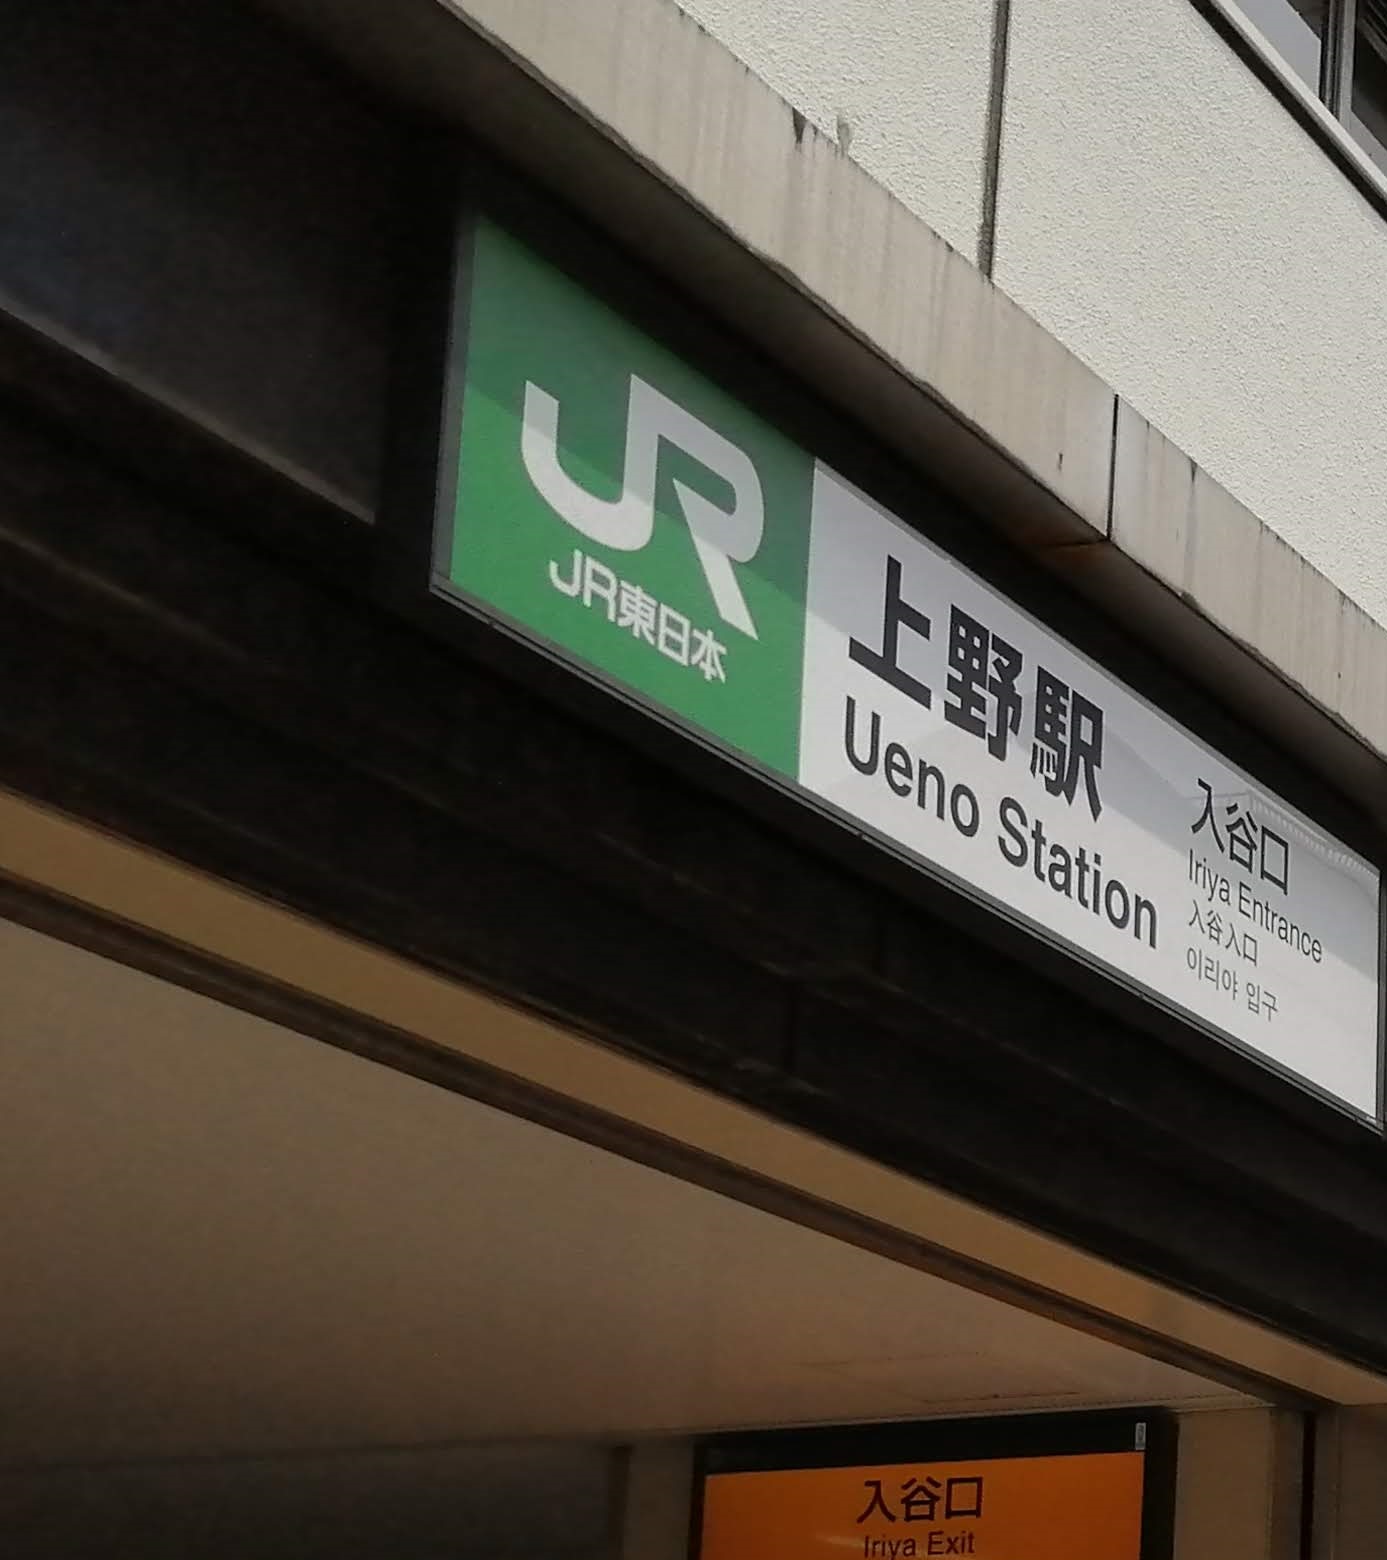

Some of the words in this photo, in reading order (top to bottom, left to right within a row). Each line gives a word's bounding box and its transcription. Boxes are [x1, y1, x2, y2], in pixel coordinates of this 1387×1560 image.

[521, 373, 765, 641] JR
[549, 549, 728, 684] JR東日本
[848, 554, 1104, 823] 上野駅
[844, 695, 980, 838] Ueno
[998, 796, 1158, 950] Station
[1190, 777, 1289, 896] 入谷口
[1188, 848, 1231, 906] Iriya
[1238, 880, 1323, 964] Entrance
[1188, 899, 1259, 968] 入谷入口
[1186, 947, 1239, 1001] 이리야
[1246, 981, 1279, 1022] 입구
[856, 1475, 984, 1524] 入谷口
[927, 1530, 976, 1557] Exit
